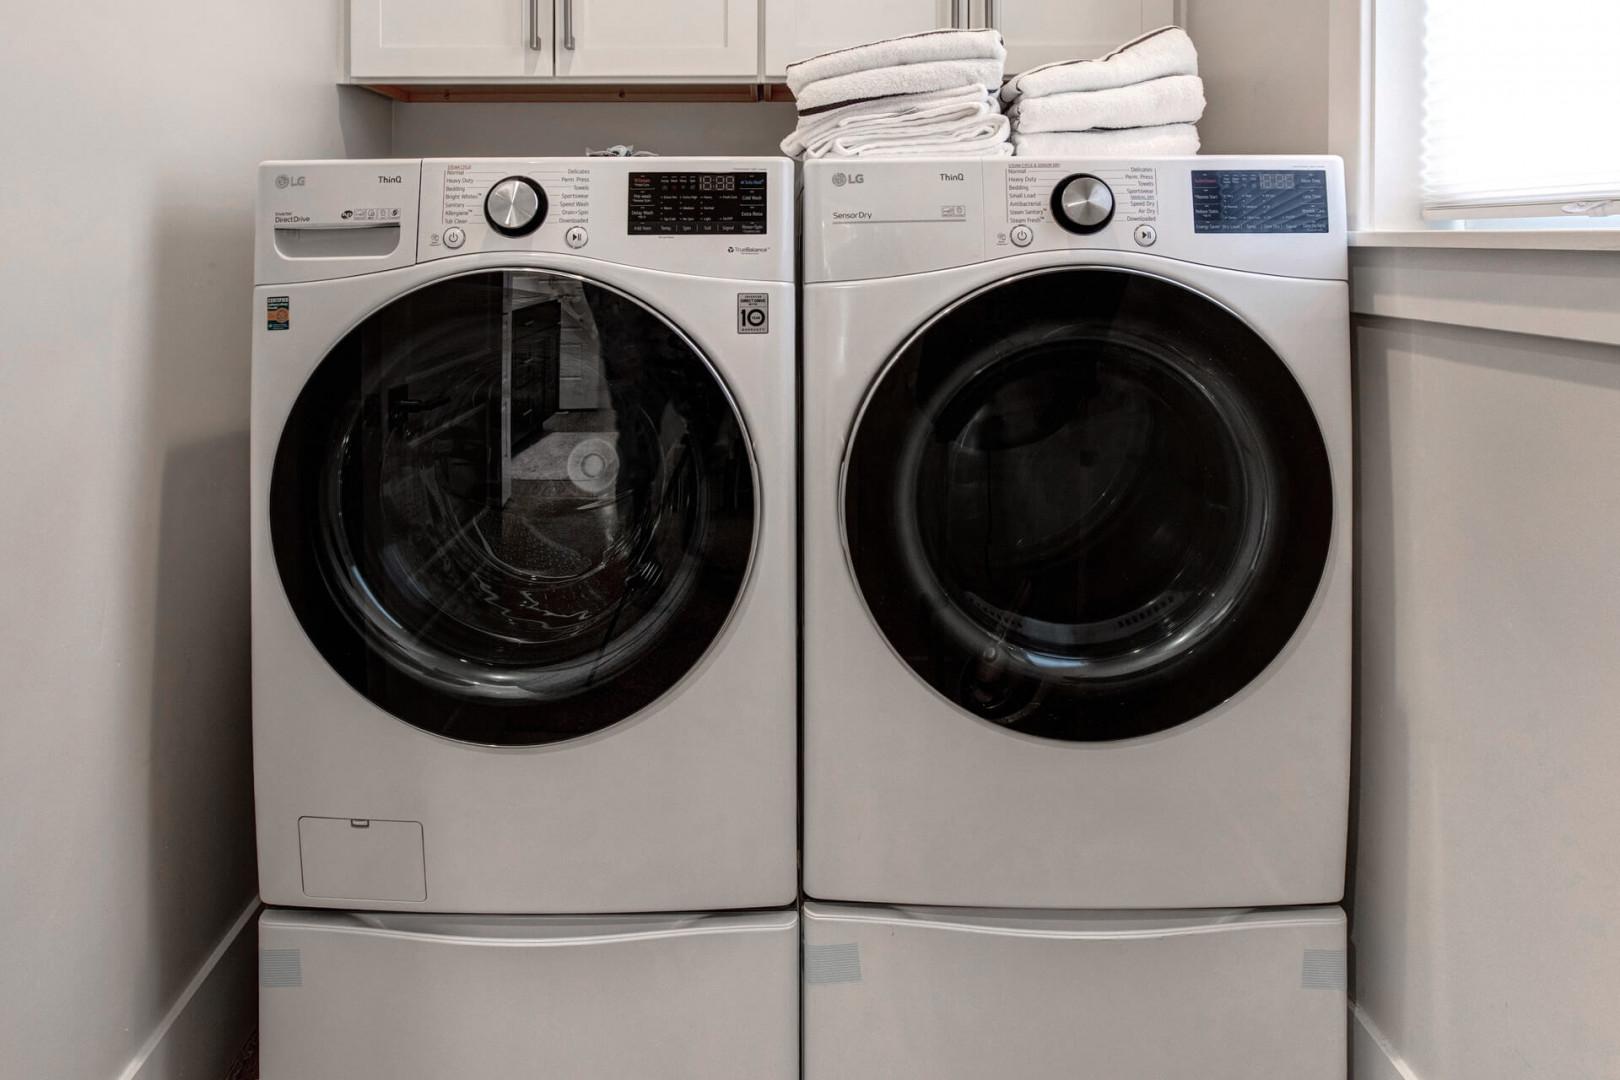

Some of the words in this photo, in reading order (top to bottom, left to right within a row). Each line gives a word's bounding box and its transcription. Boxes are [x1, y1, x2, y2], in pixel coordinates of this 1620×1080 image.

[291, 177, 305, 186] LG
[848, 174, 864, 184] LG
[940, 173, 964, 181] ThinQ
[833, 211, 872, 219] SensorDry
[741, 309, 765, 326] 10
